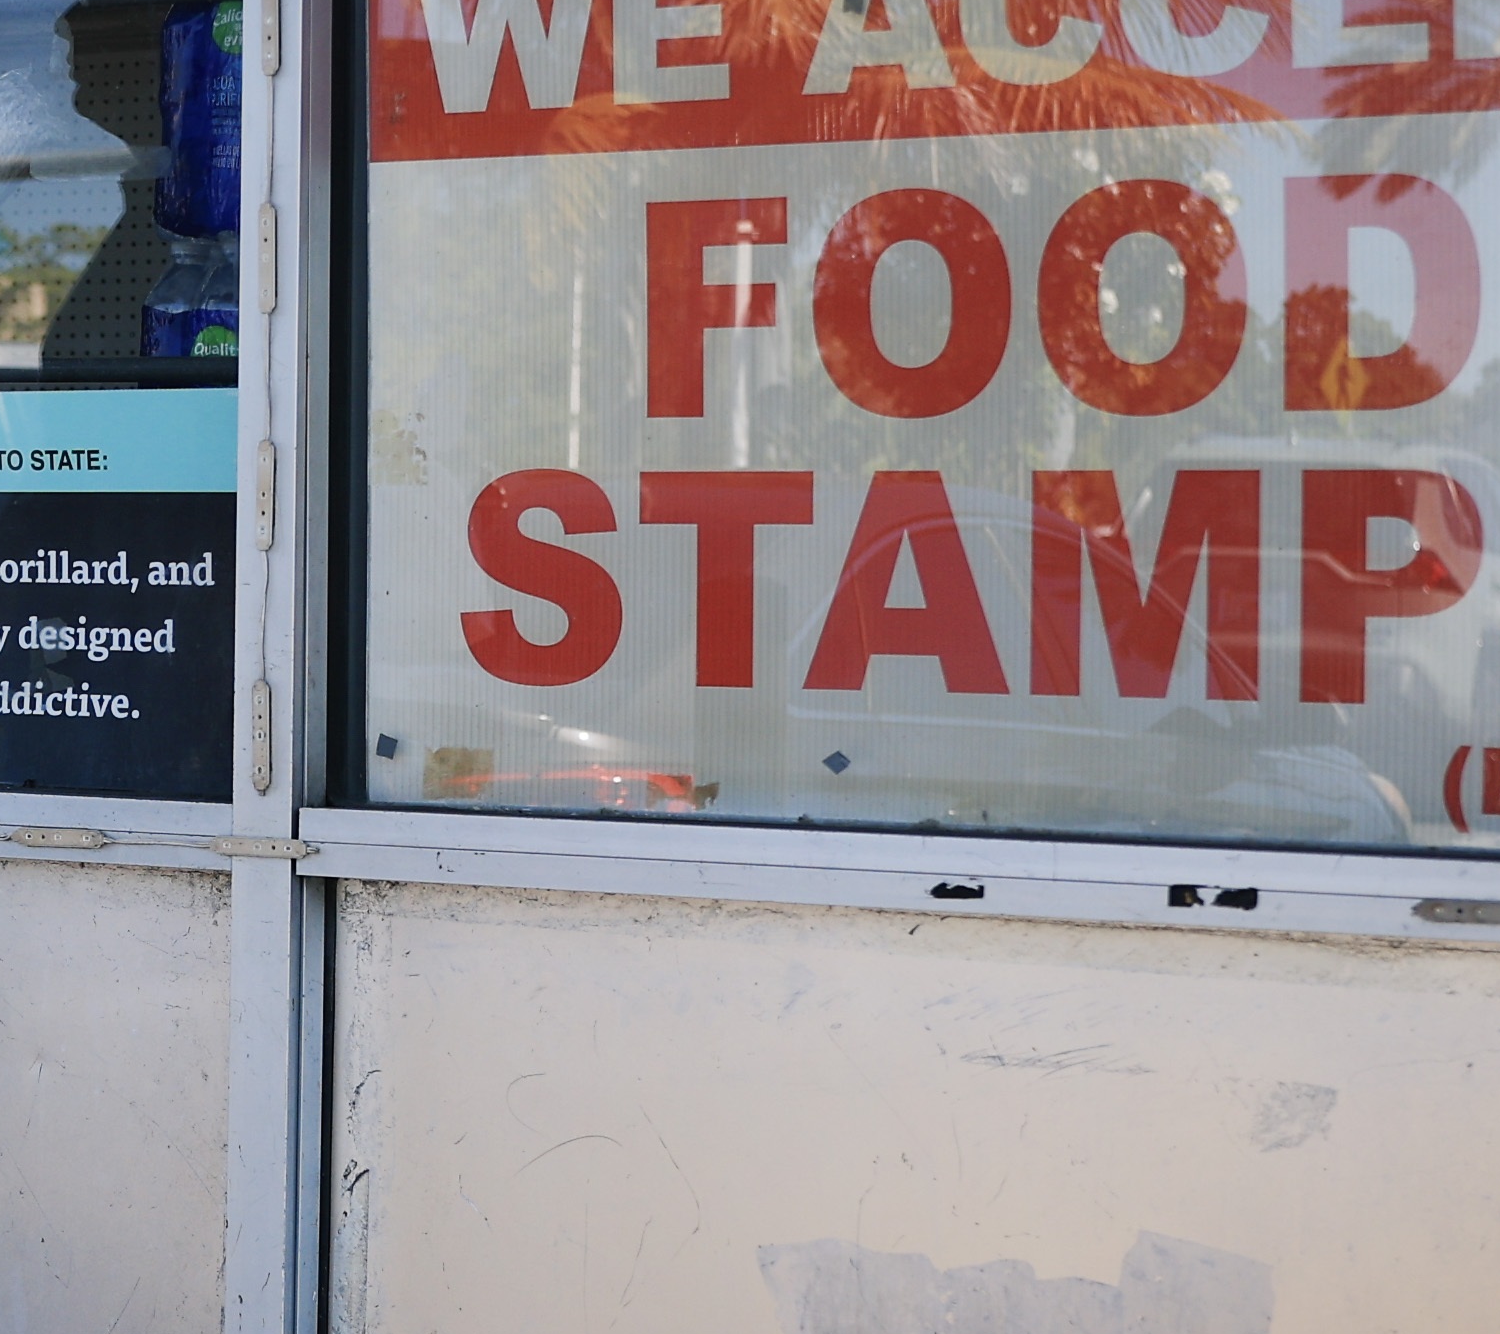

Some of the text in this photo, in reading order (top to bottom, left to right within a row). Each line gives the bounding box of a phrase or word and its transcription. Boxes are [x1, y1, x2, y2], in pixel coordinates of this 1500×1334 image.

[646, 173, 1482, 419] FOOD
[30, 450, 109, 471] STATE:
[148, 551, 216, 588] and
[18, 616, 176, 662] designed
